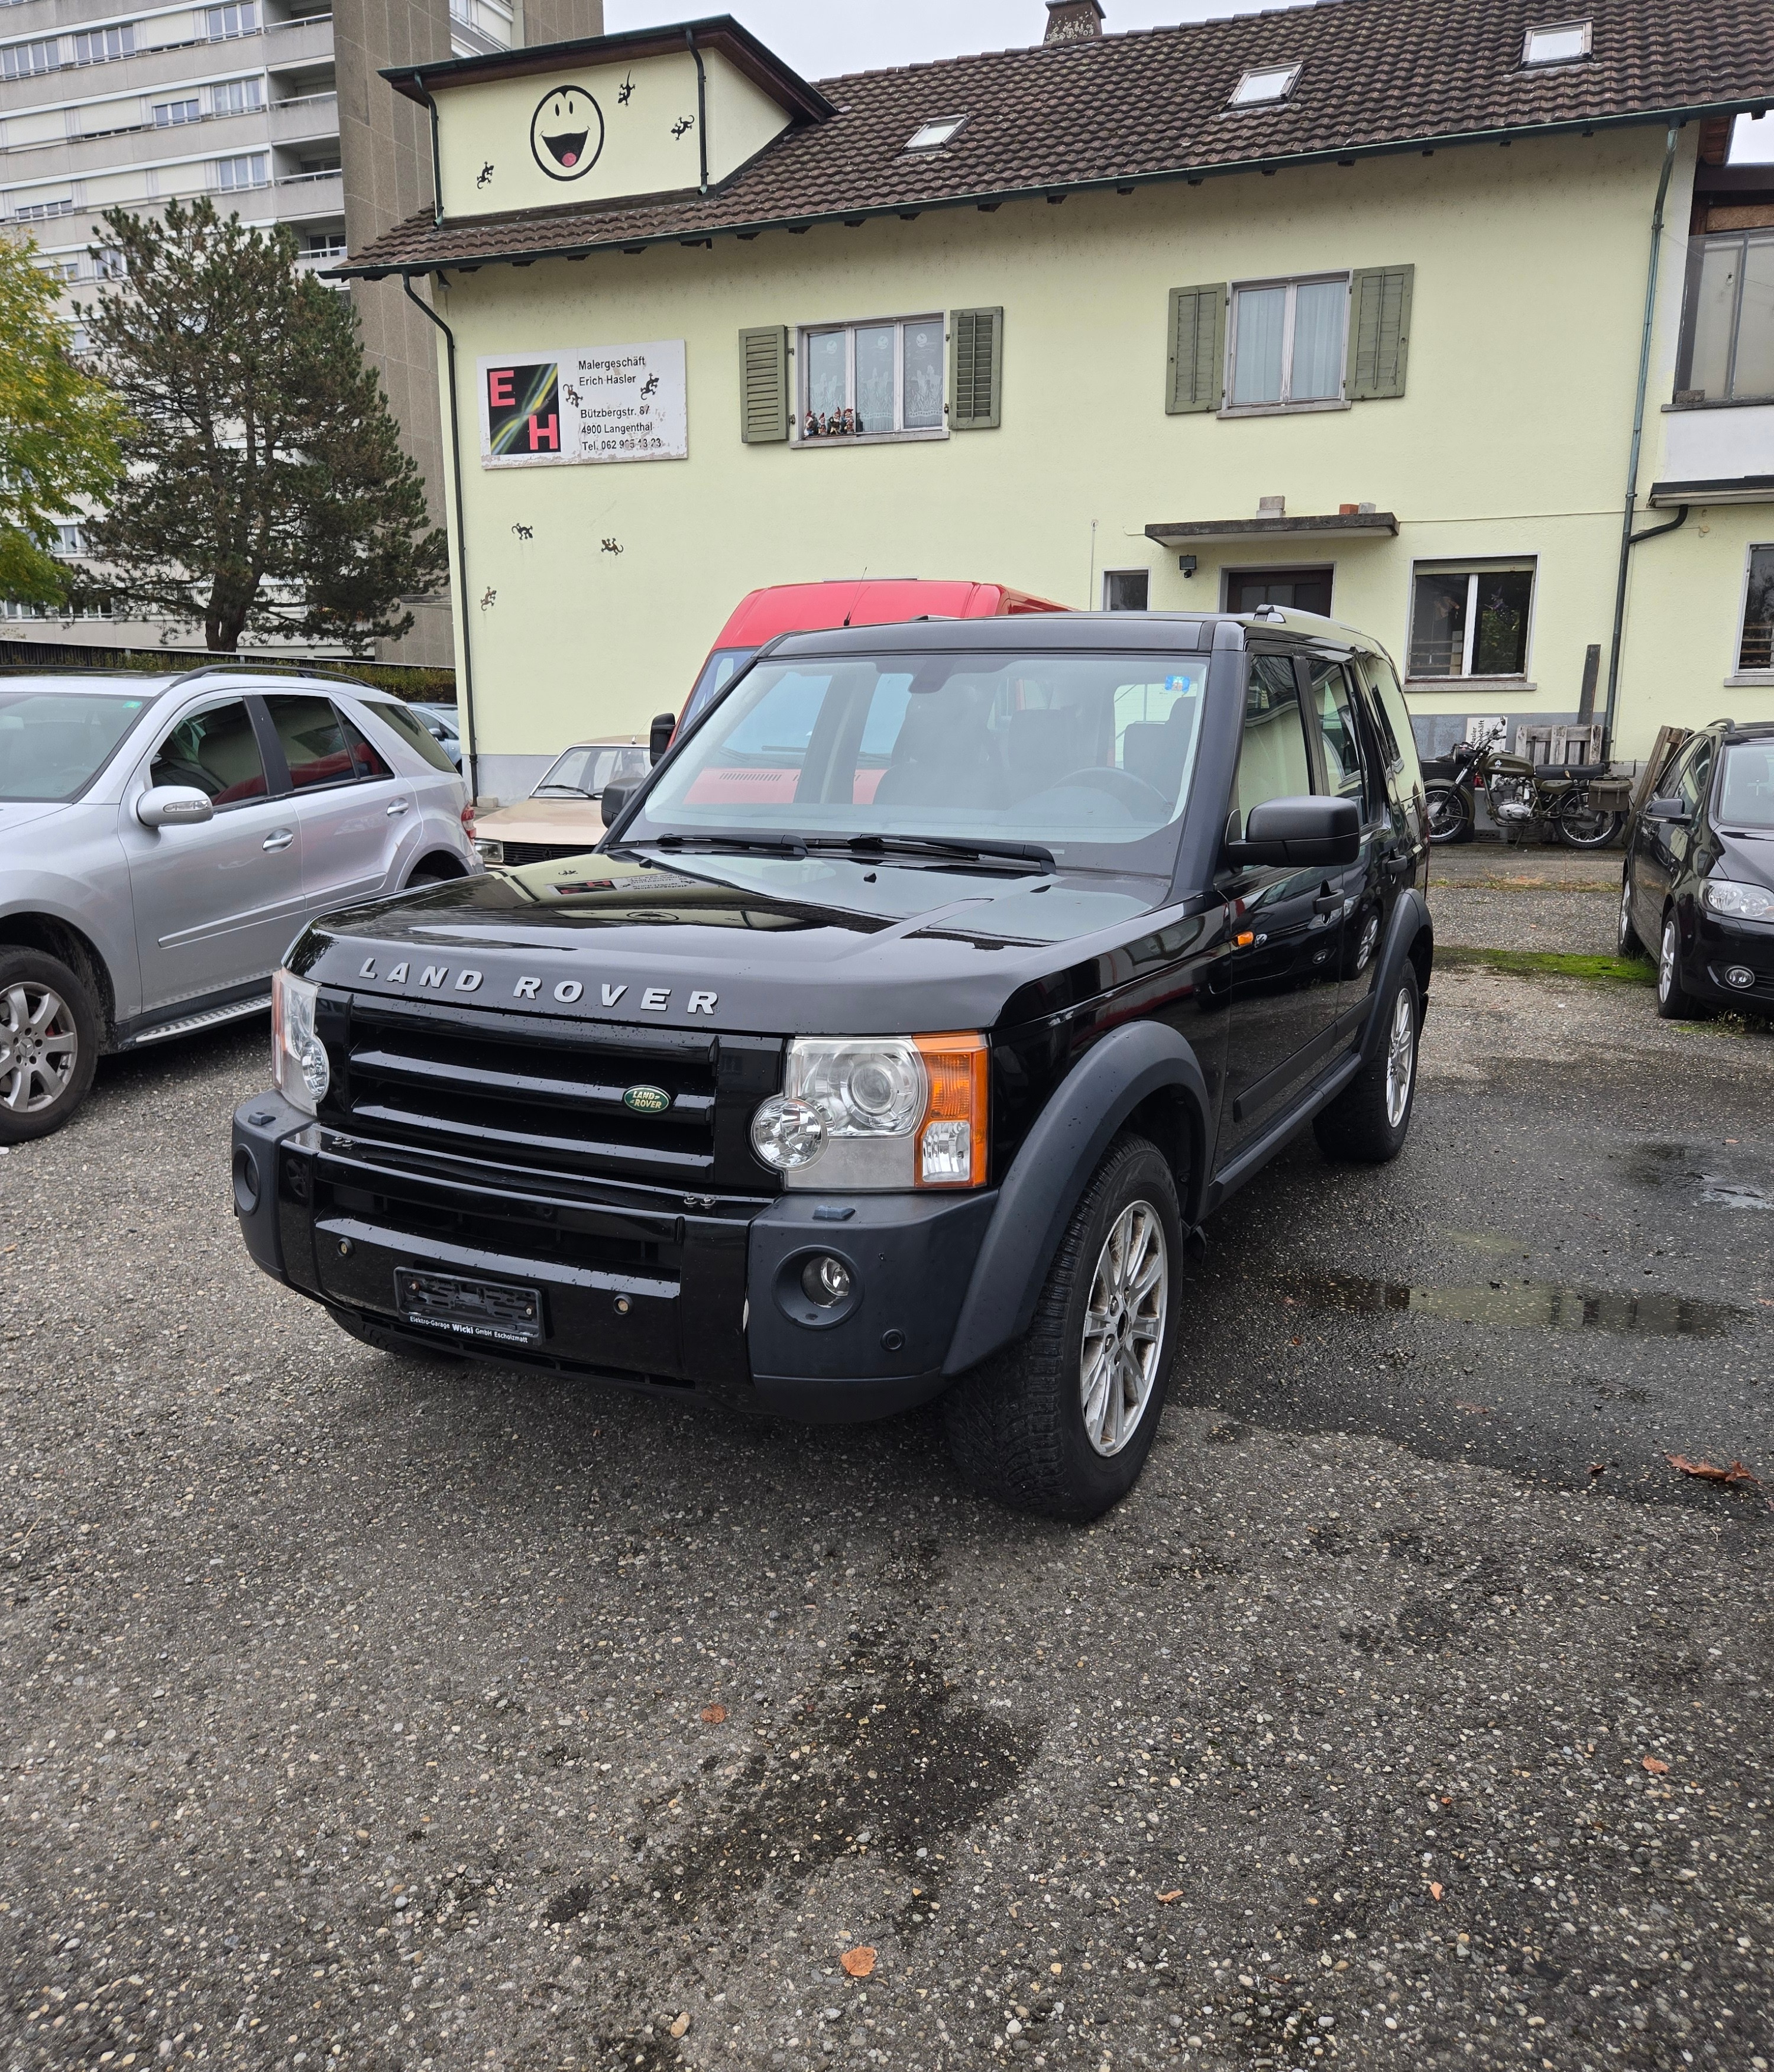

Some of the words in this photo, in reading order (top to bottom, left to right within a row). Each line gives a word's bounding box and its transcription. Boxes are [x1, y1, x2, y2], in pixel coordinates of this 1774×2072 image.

[578, 356, 645, 371] Malergeschäft
[579, 375, 603, 386] Erich
[606, 374, 636, 384] Hasler
[490, 370, 516, 407] E
[580, 407, 637, 419] Bützbergstr.
[529, 414, 558, 450] H
[581, 424, 602, 435] 4900
[604, 422, 653, 435] Langenthal
[582, 441, 598, 451] Tel.
[601, 440, 617, 449] 062
[358, 957, 484, 992] LAND
[513, 976, 718, 1015] ROVER
[632, 1091, 655, 1100] LAND
[634, 1099, 662, 1109] ROVER
[410, 1316, 451, 1329] Elektro-Garage
[452, 1323, 474, 1335] Wicki
[475, 1328, 492, 1336] GmbH
[494, 1331, 528, 1343] Escholzmatt
